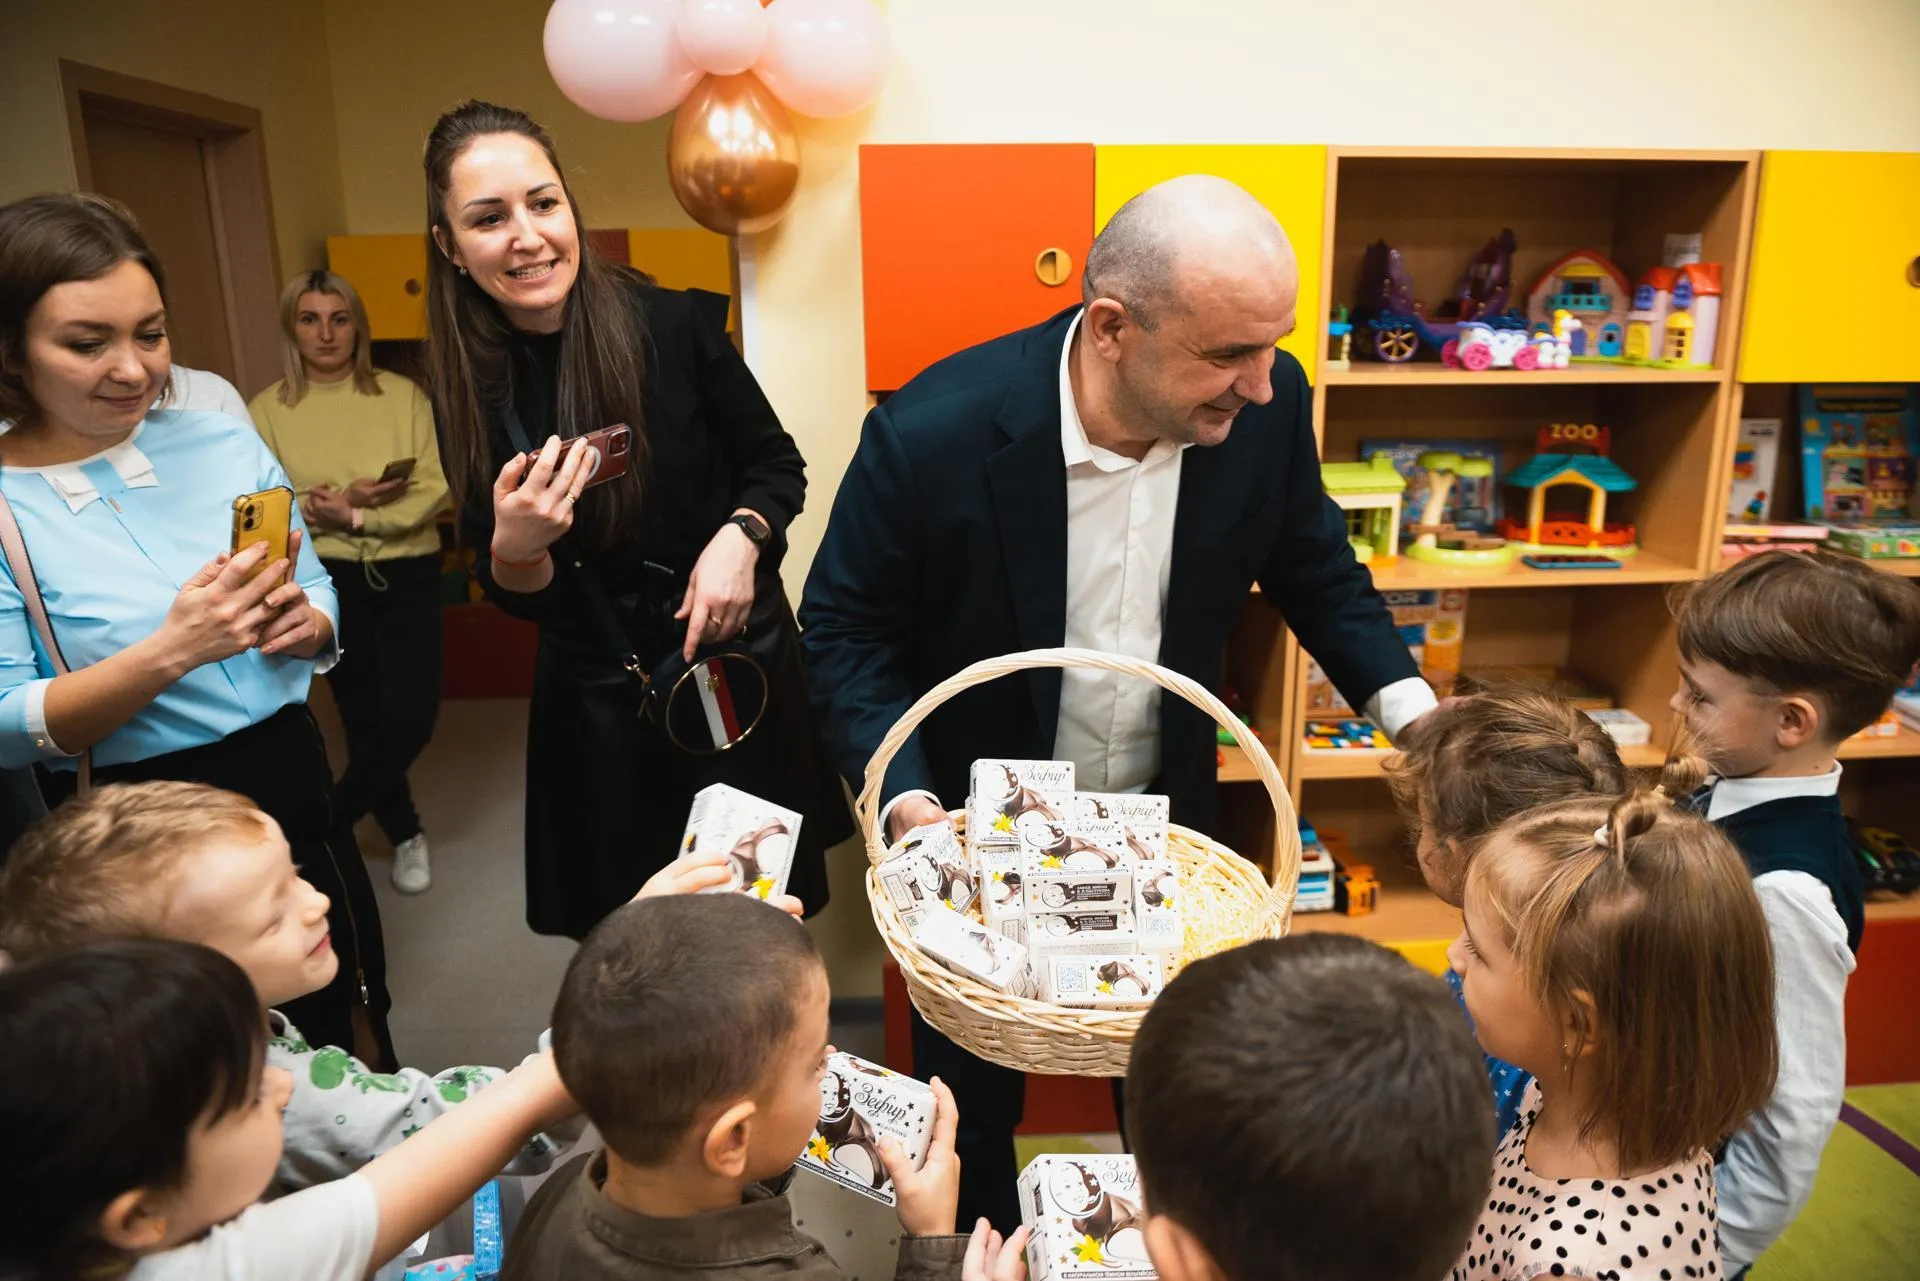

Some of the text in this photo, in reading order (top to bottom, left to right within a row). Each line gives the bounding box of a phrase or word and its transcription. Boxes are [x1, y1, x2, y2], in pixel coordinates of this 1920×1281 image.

[1549, 423, 1599, 441] ZOO
[1021, 764, 1066, 786] Зефир
[1111, 799, 1157, 820] Зефир
[854, 1082, 907, 1125] Зефир
